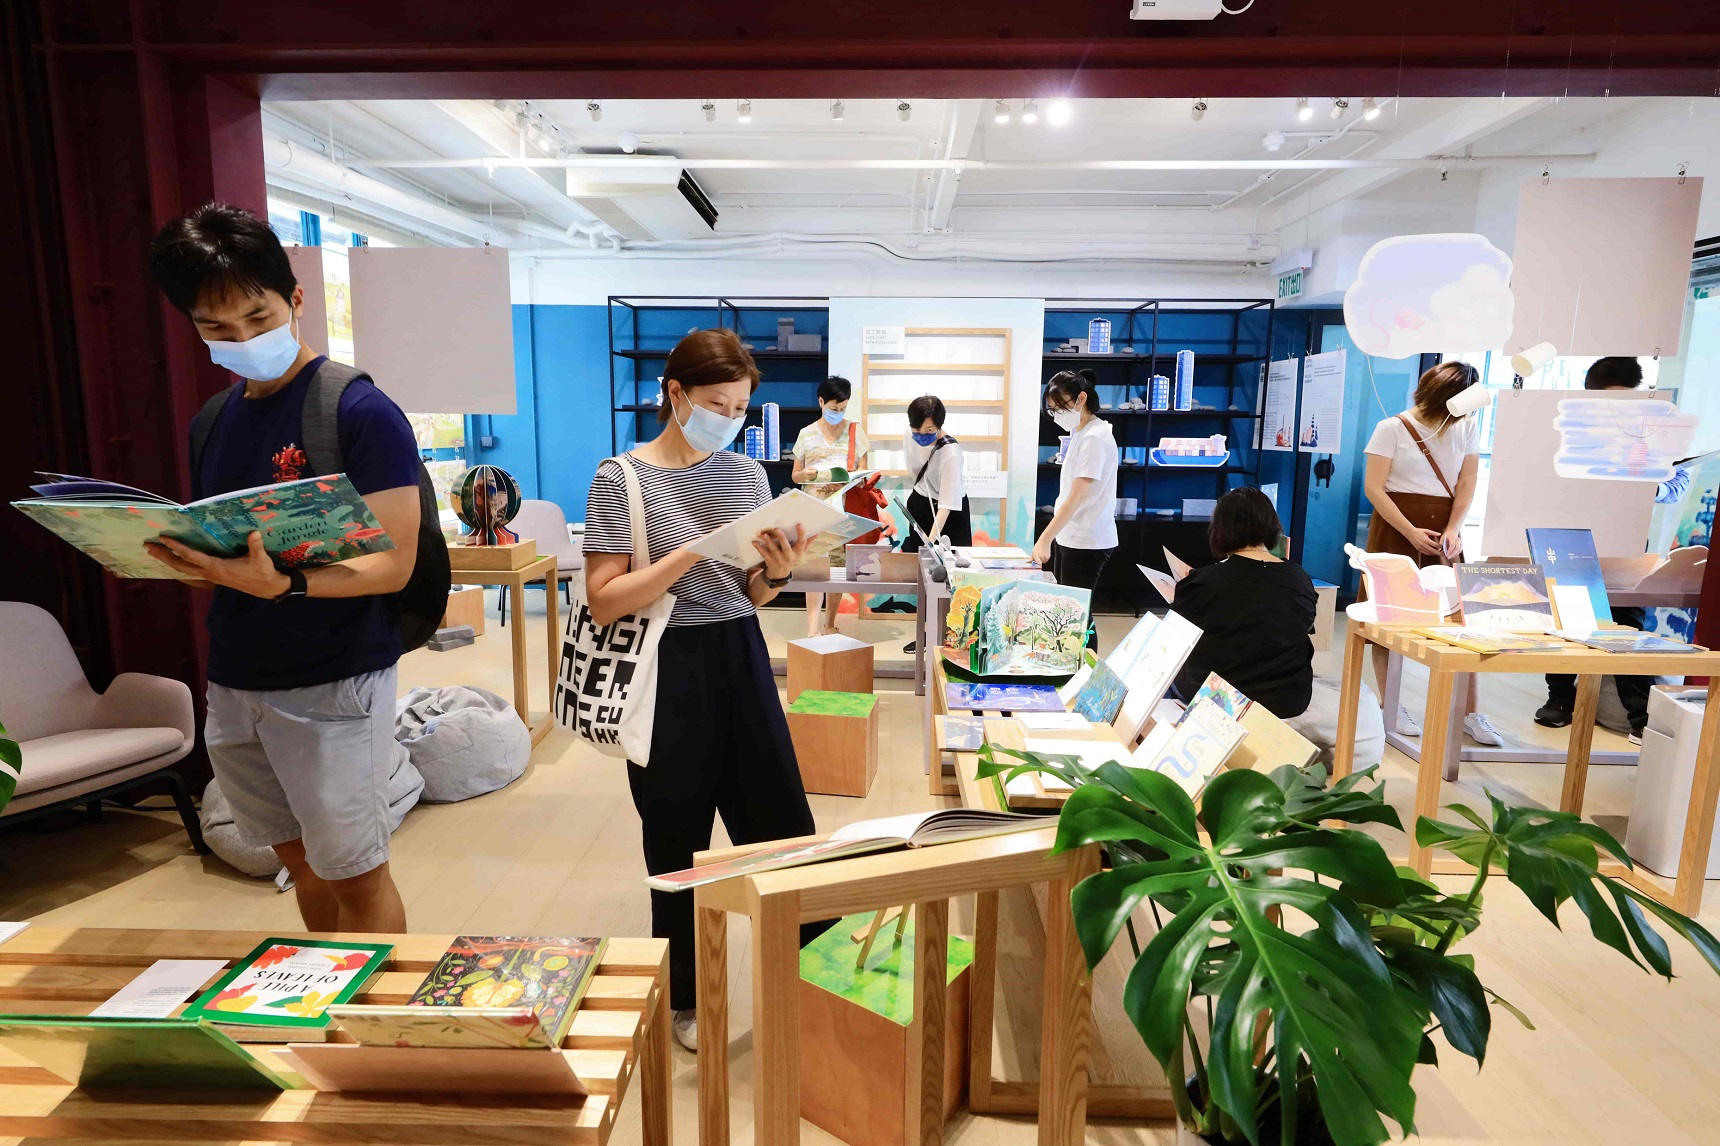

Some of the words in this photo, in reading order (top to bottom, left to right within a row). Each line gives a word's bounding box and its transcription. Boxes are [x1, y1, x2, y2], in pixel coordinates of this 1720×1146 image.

[1278, 275, 1291, 299] EXIT
[1290, 272, 1301, 295] 出口
[266, 520, 328, 538] Garden
[277, 528, 328, 546] Jungle
[1461, 566, 1480, 574] THE
[1480, 567, 1521, 575] SHORTEST
[596, 705, 624, 725] CU
[253, 970, 314, 982] LEAVES
[316, 974, 339, 984] OF
[258, 982, 299, 993] PILE
[300, 984, 314, 993] A
